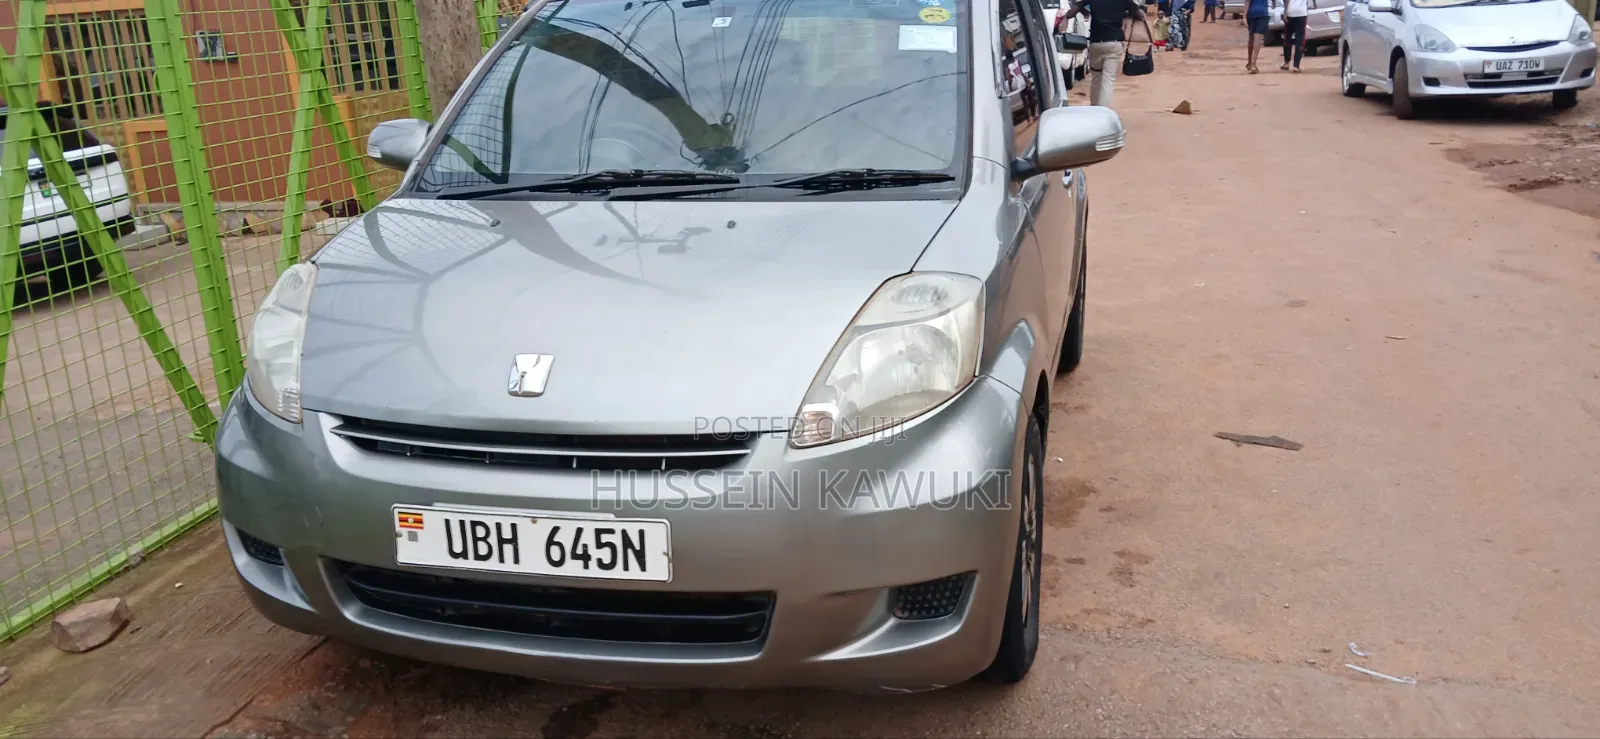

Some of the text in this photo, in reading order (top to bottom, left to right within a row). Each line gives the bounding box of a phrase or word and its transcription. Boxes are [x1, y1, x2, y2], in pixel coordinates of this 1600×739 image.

[1496, 60, 1541, 71] UAZ 710W
[444, 518, 647, 573] UBH 645N
